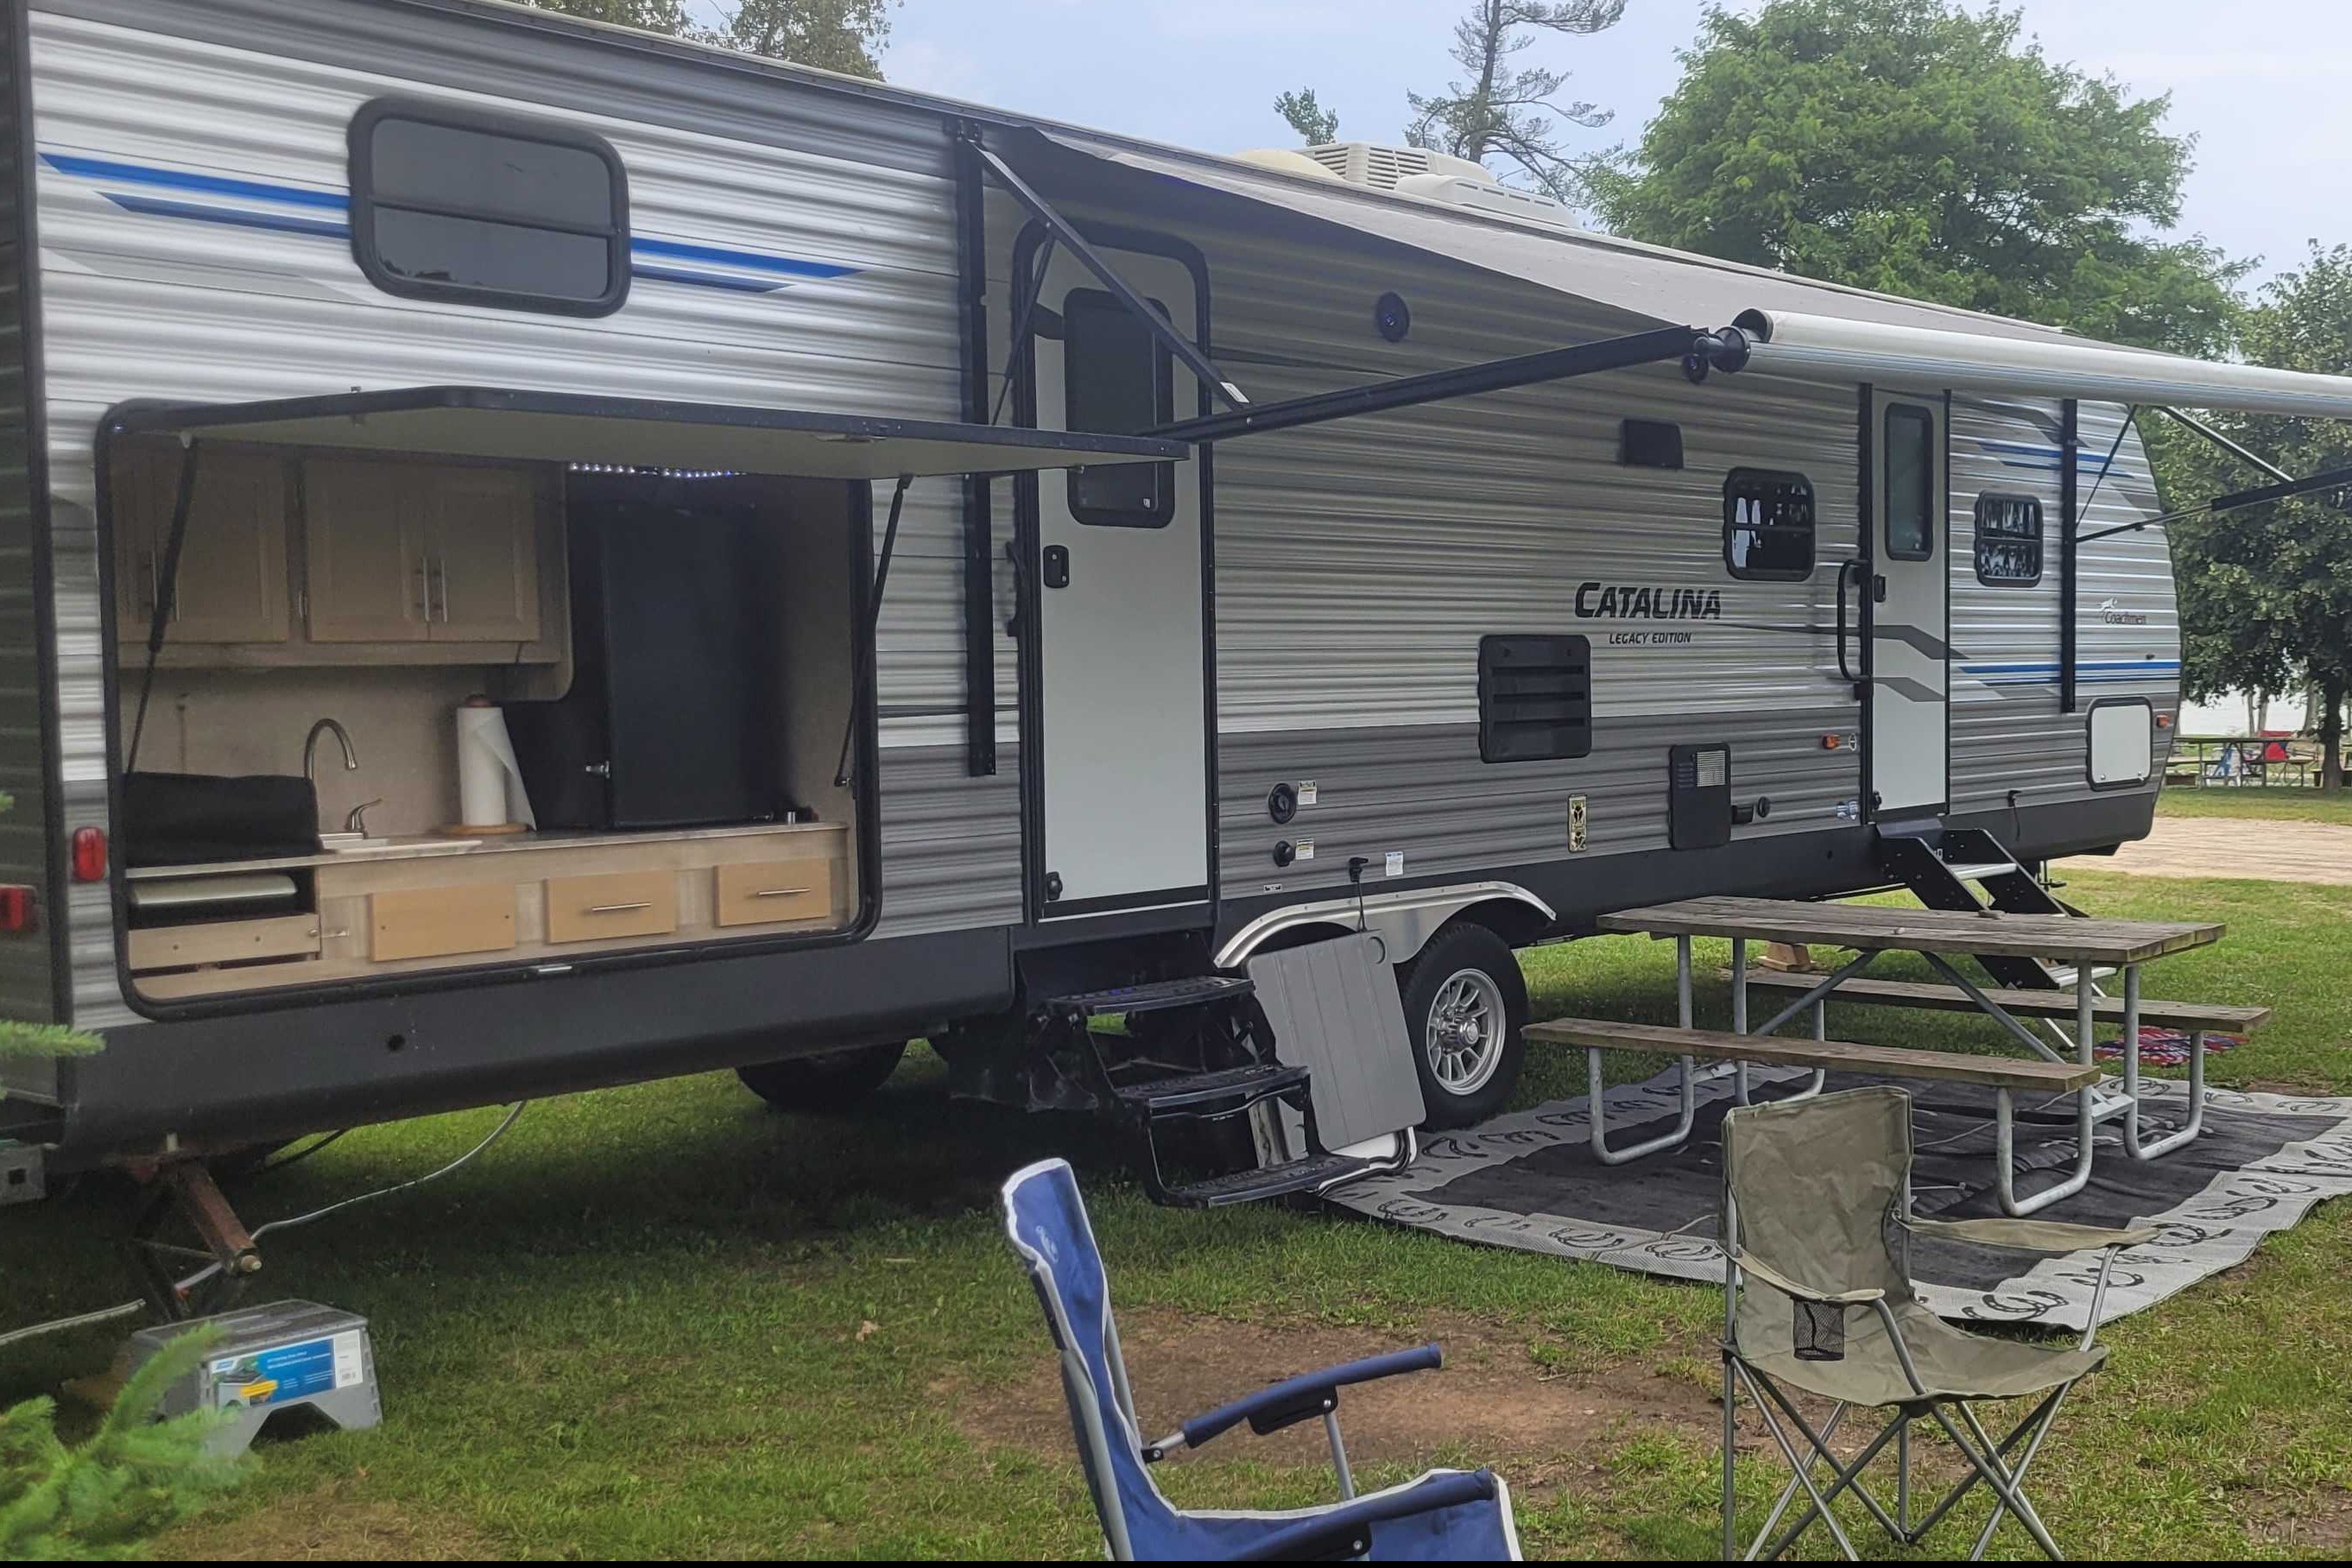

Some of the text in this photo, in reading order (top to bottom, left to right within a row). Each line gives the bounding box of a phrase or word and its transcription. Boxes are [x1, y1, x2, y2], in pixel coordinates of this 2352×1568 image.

[1575, 582, 1721, 619] CATALINA
[1609, 632, 1692, 644] LEGACY EDITION
